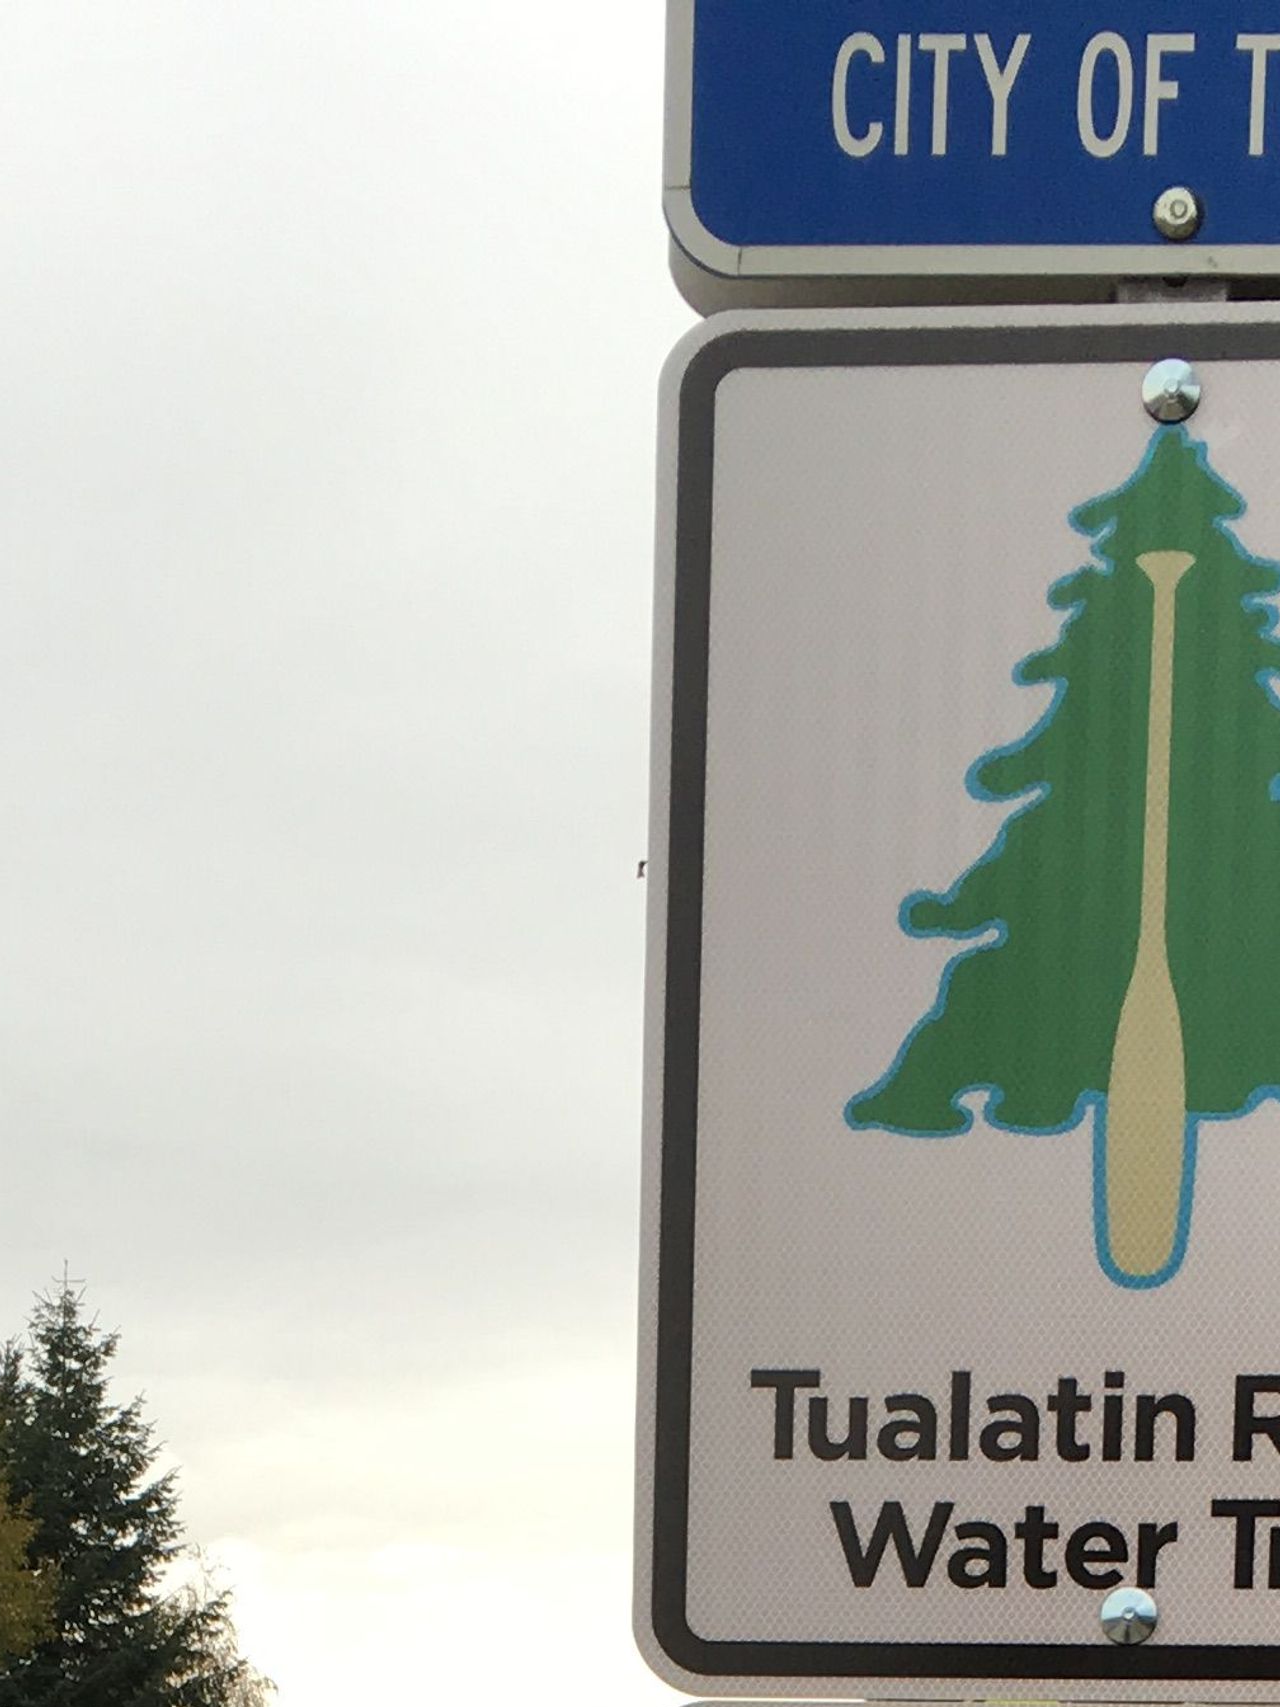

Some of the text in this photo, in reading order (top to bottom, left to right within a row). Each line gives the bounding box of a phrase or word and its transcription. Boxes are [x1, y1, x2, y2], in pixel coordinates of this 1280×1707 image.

[832, 32, 1031, 157] CITY
[1078, 32, 1195, 157] OF
[751, 1369, 1196, 1462] Tualatin
[830, 1501, 1178, 1589] Water
